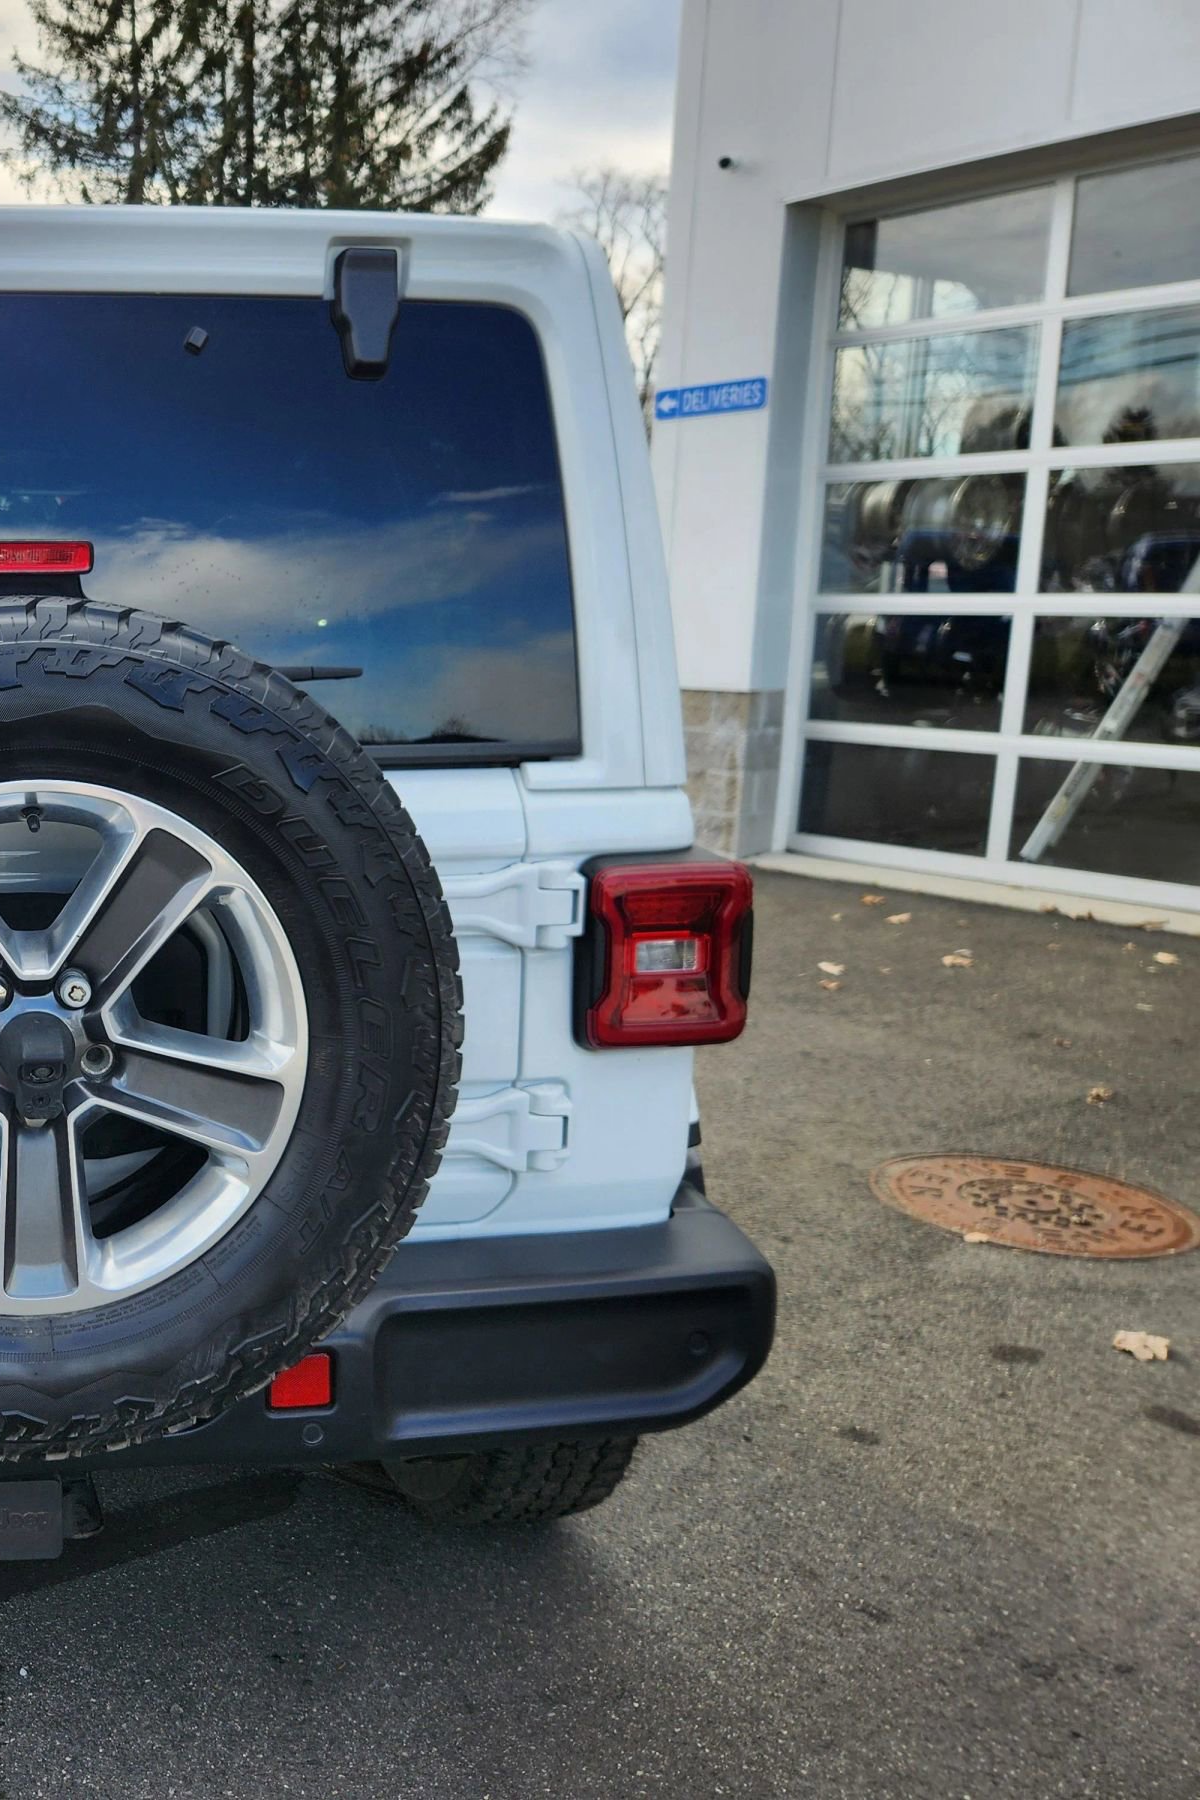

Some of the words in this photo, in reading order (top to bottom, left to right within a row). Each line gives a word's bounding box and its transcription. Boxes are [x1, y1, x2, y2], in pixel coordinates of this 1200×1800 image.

[683, 381, 762, 412] DELIVERIES
[211, 762, 395, 1135] DUELER
[299, 1147, 354, 1255] A/T
